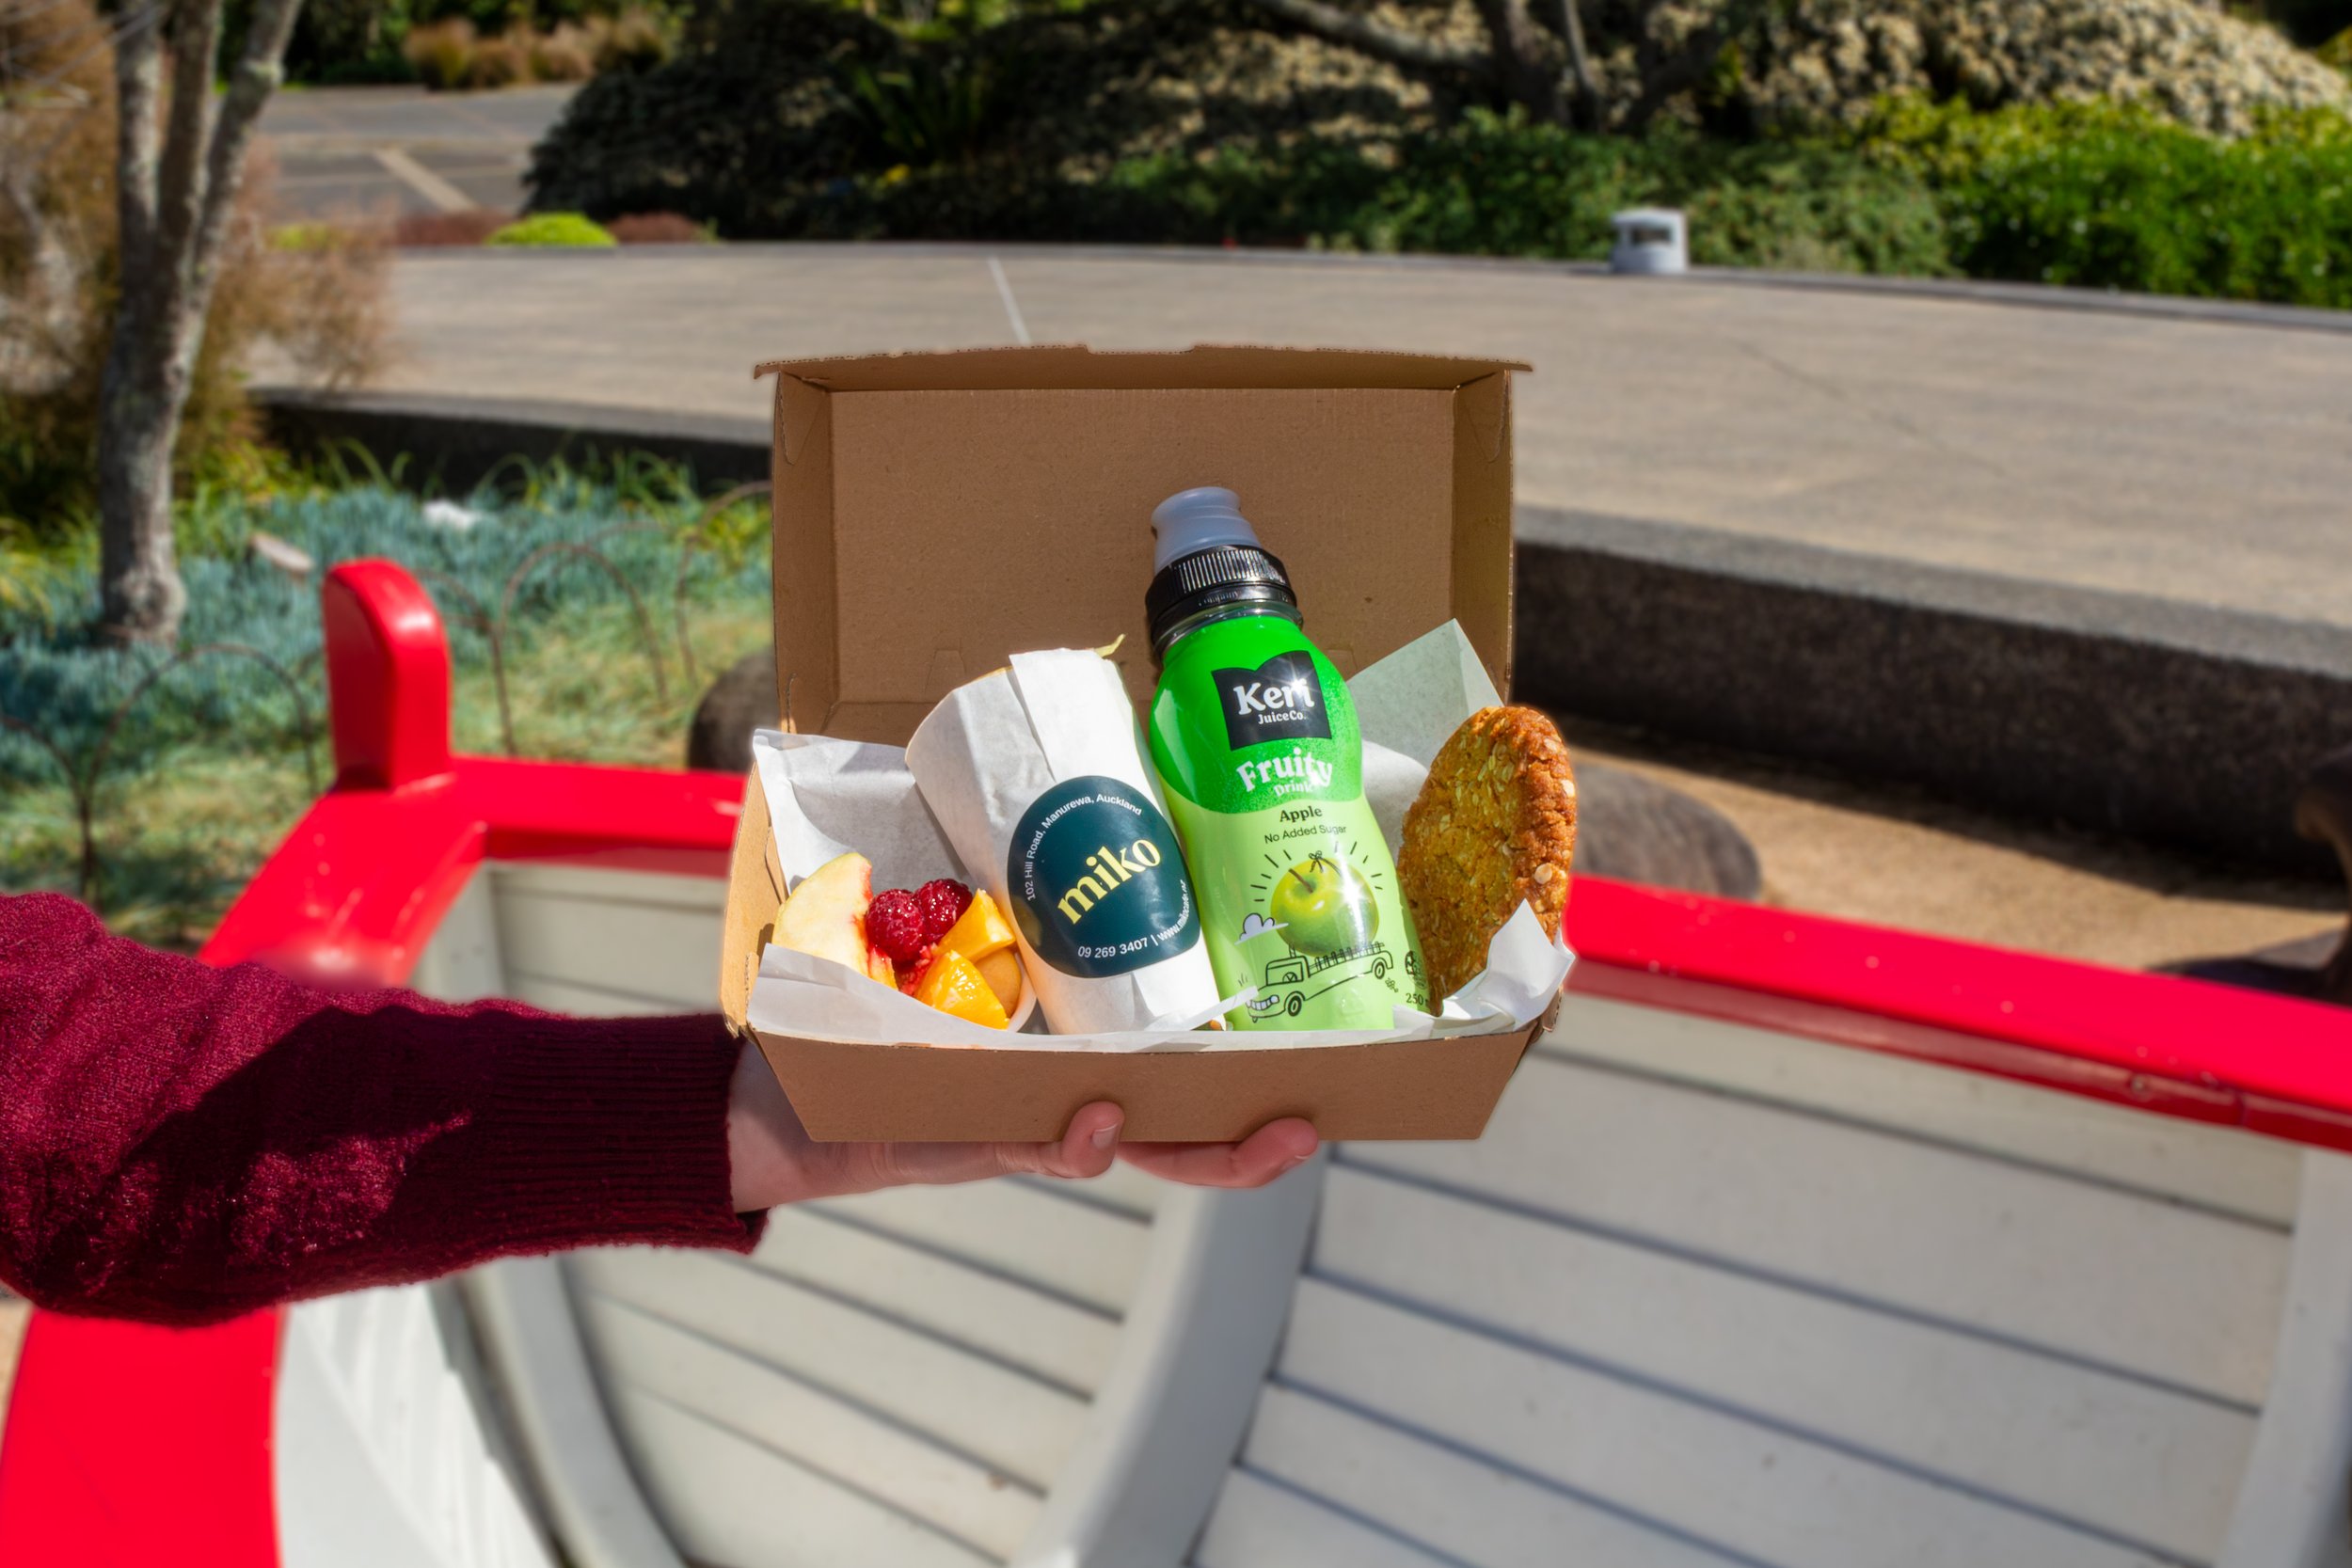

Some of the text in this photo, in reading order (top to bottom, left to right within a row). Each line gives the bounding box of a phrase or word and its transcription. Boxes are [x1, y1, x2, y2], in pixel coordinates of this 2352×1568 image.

[1233, 678, 1315, 715] Keri
[1236, 747, 1333, 793] Fruity
[1279, 805, 1323, 823] Apple
[1025, 794, 1142, 902] 102 Hill Road, Manurewa, Auckland
[1264, 824, 1346, 844] No Added Sugar
[1057, 839, 1161, 926] miko
[1077, 945, 1091, 958] 09
[1094, 944, 1116, 959] 269
[1120, 937, 1149, 956] 3407
[1406, 992, 1424, 1006] 250
